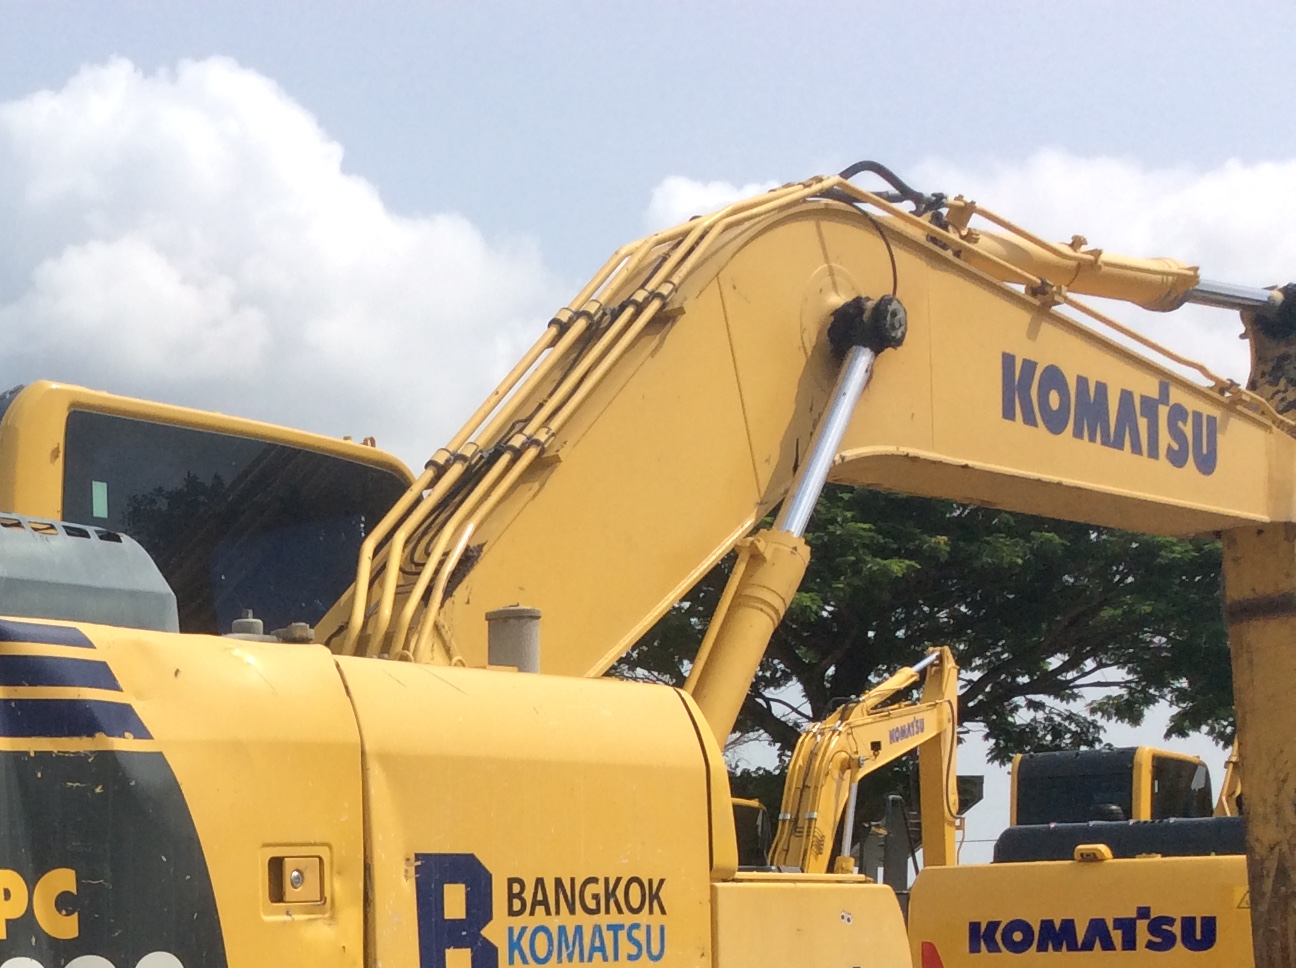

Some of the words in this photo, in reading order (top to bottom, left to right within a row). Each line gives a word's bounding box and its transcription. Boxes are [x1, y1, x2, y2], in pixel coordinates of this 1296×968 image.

[1001, 351, 1218, 476] KOMATSU
[889, 716, 924, 744] KOMATSU
[507, 876, 667, 917] BANGKOK
[507, 923, 666, 966] KOMATSU
[968, 906, 1217, 953] KOMATSU
